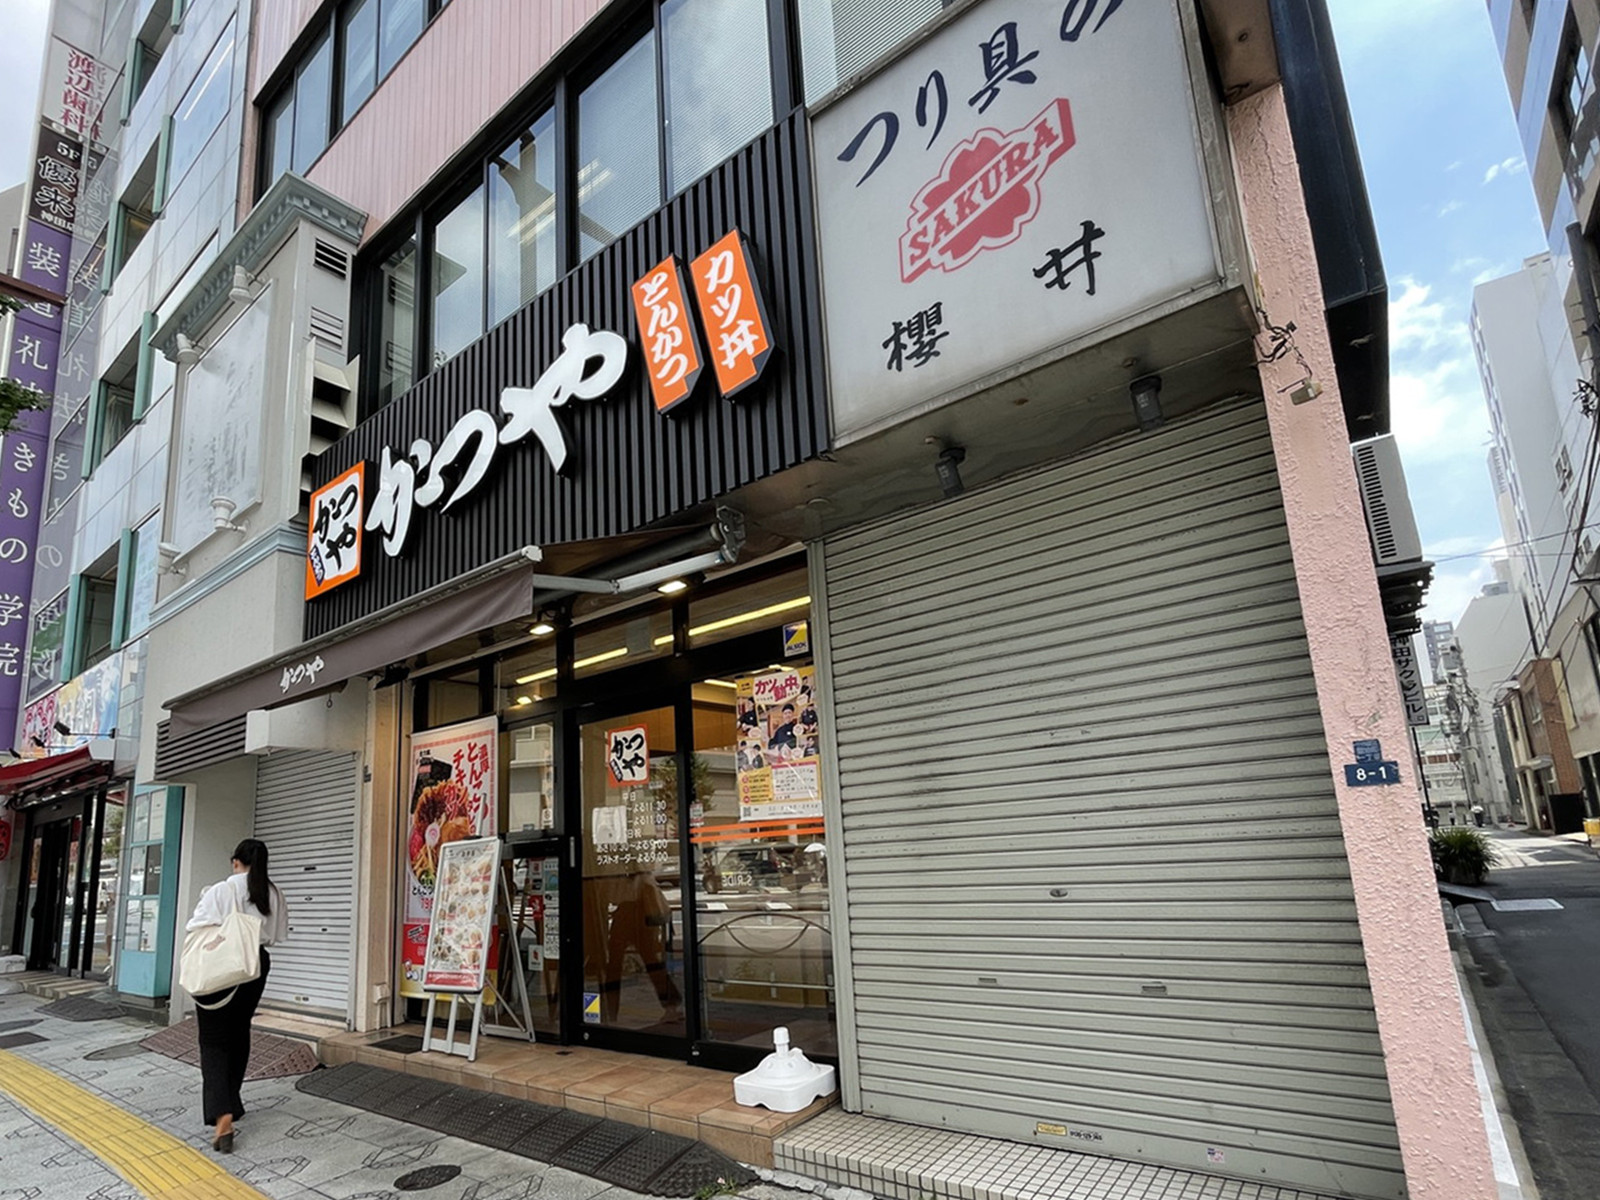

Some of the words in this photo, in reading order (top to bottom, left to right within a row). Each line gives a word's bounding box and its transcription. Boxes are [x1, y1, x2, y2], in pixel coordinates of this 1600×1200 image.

[57, 142, 81, 159] 5F
[908, 117, 1060, 267] SAKURA
[640, 272, 689, 388] とんかつ
[704, 250, 759, 370] カツ丼
[365, 322, 628, 558] かつや
[313, 483, 359, 572] かつや
[280, 655, 324, 694] かつや
[611, 733, 645, 778] かつや
[1356, 766, 1387, 781] 8-1
